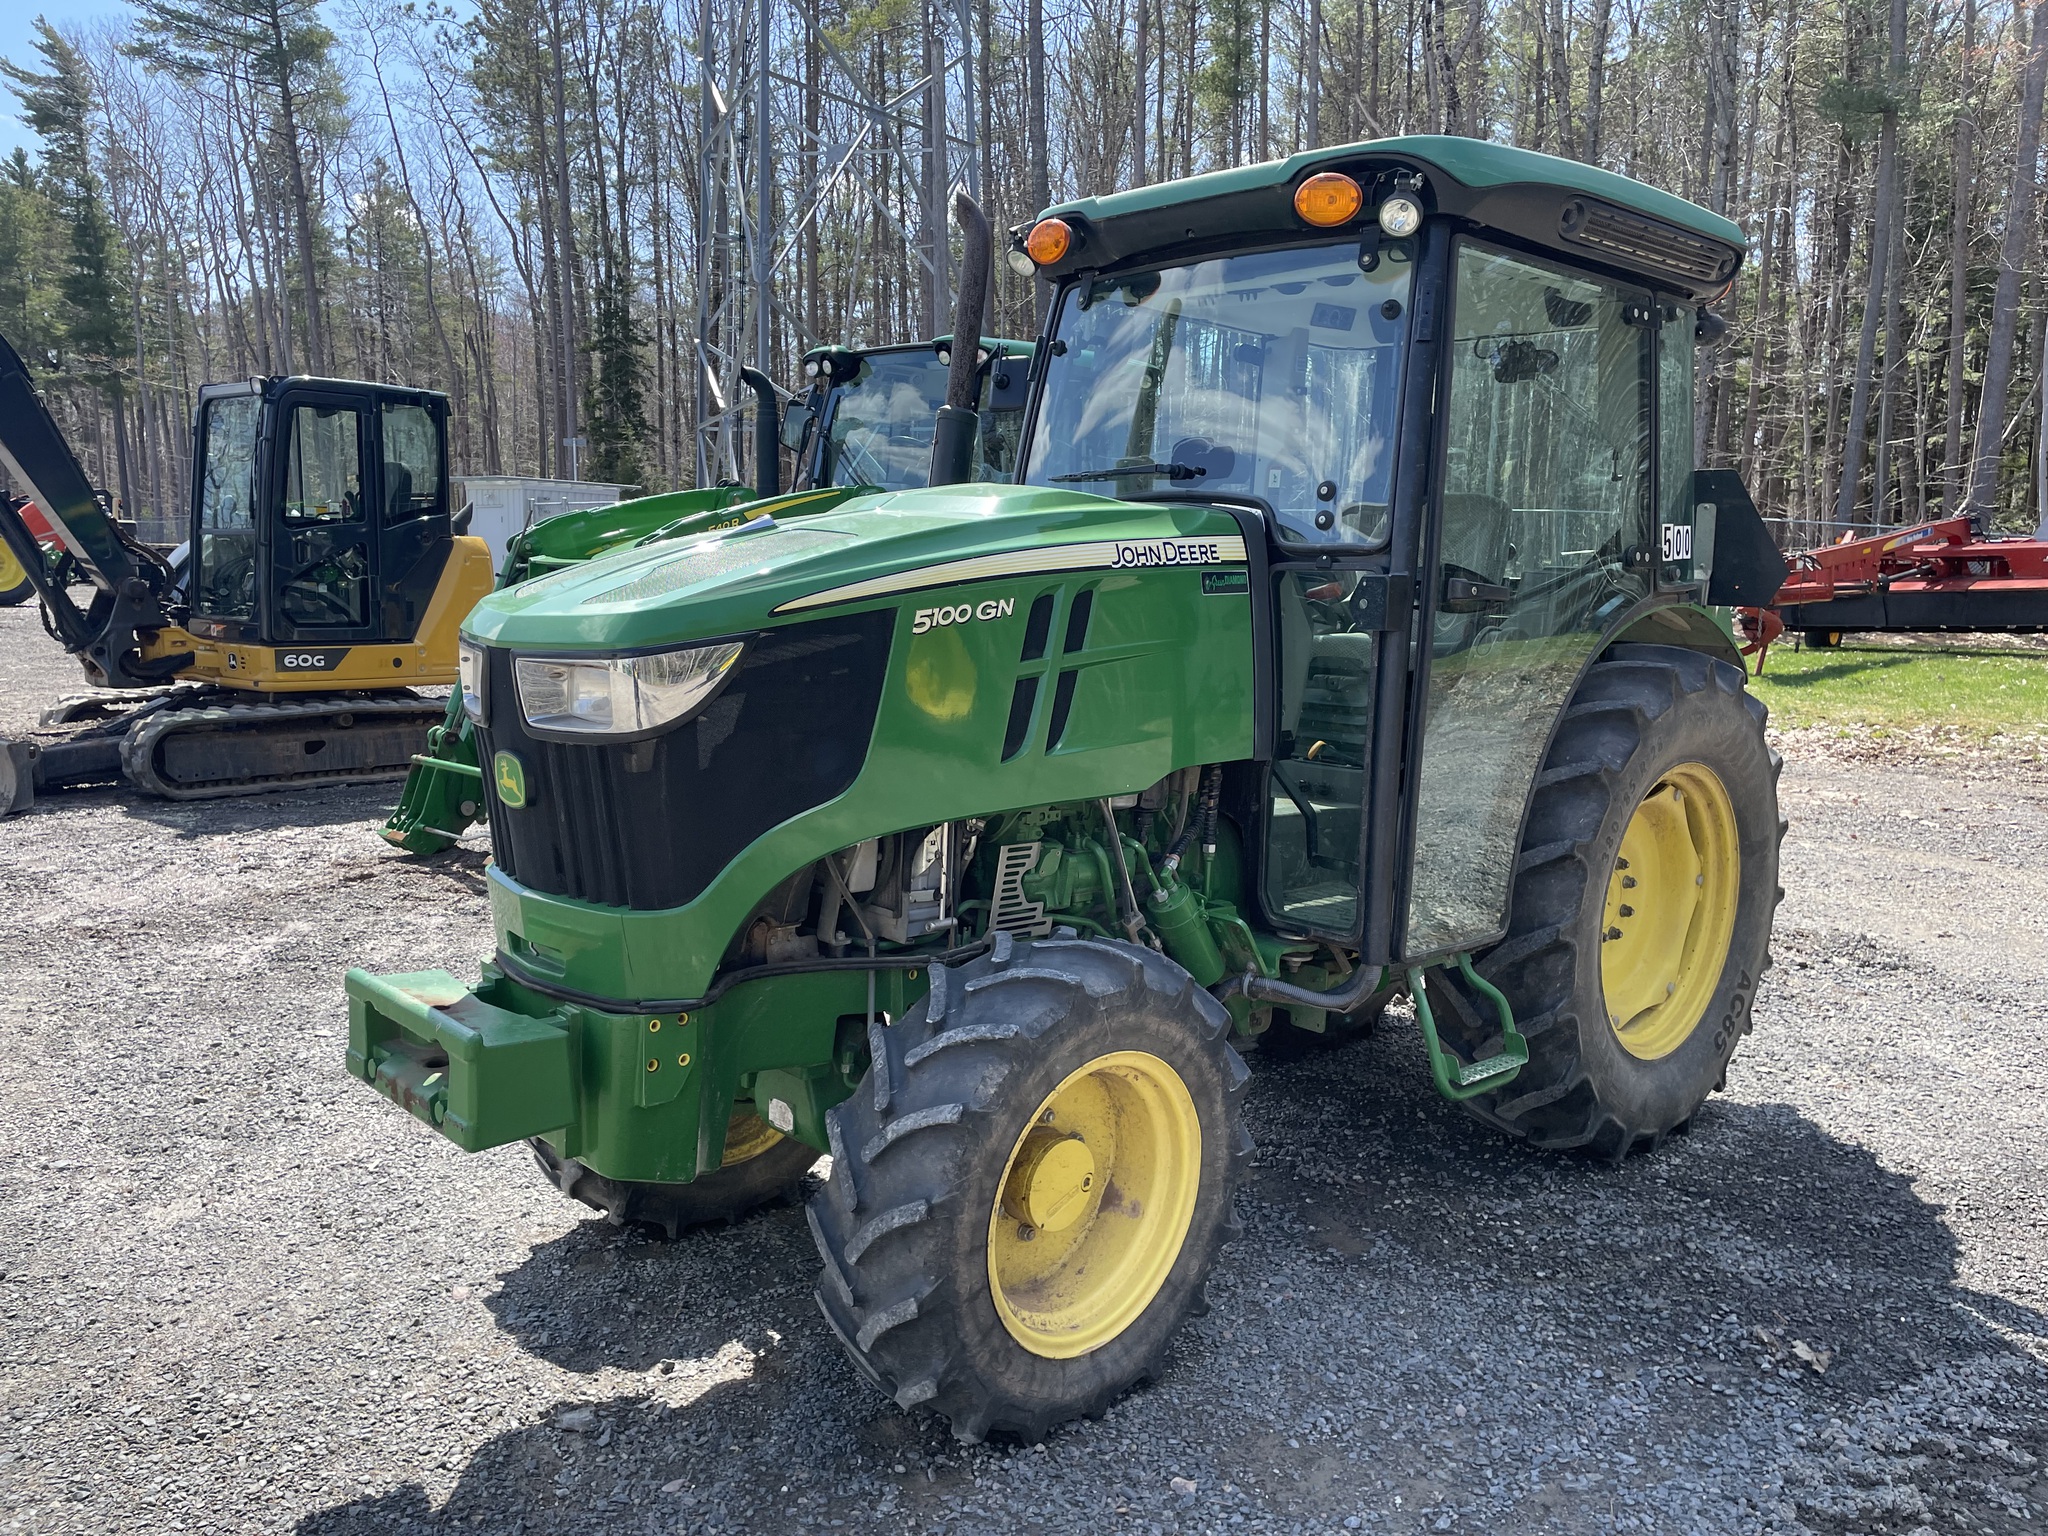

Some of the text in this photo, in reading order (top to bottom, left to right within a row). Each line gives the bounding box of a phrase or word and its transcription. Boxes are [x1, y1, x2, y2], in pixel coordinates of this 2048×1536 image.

[1111, 541, 1221, 568] JOHN DEERE
[1664, 526, 1690, 559] 500
[912, 597, 1015, 635] 5100 GN
[283, 654, 325, 668] 60G
[1713, 968, 1752, 1059] AC85
